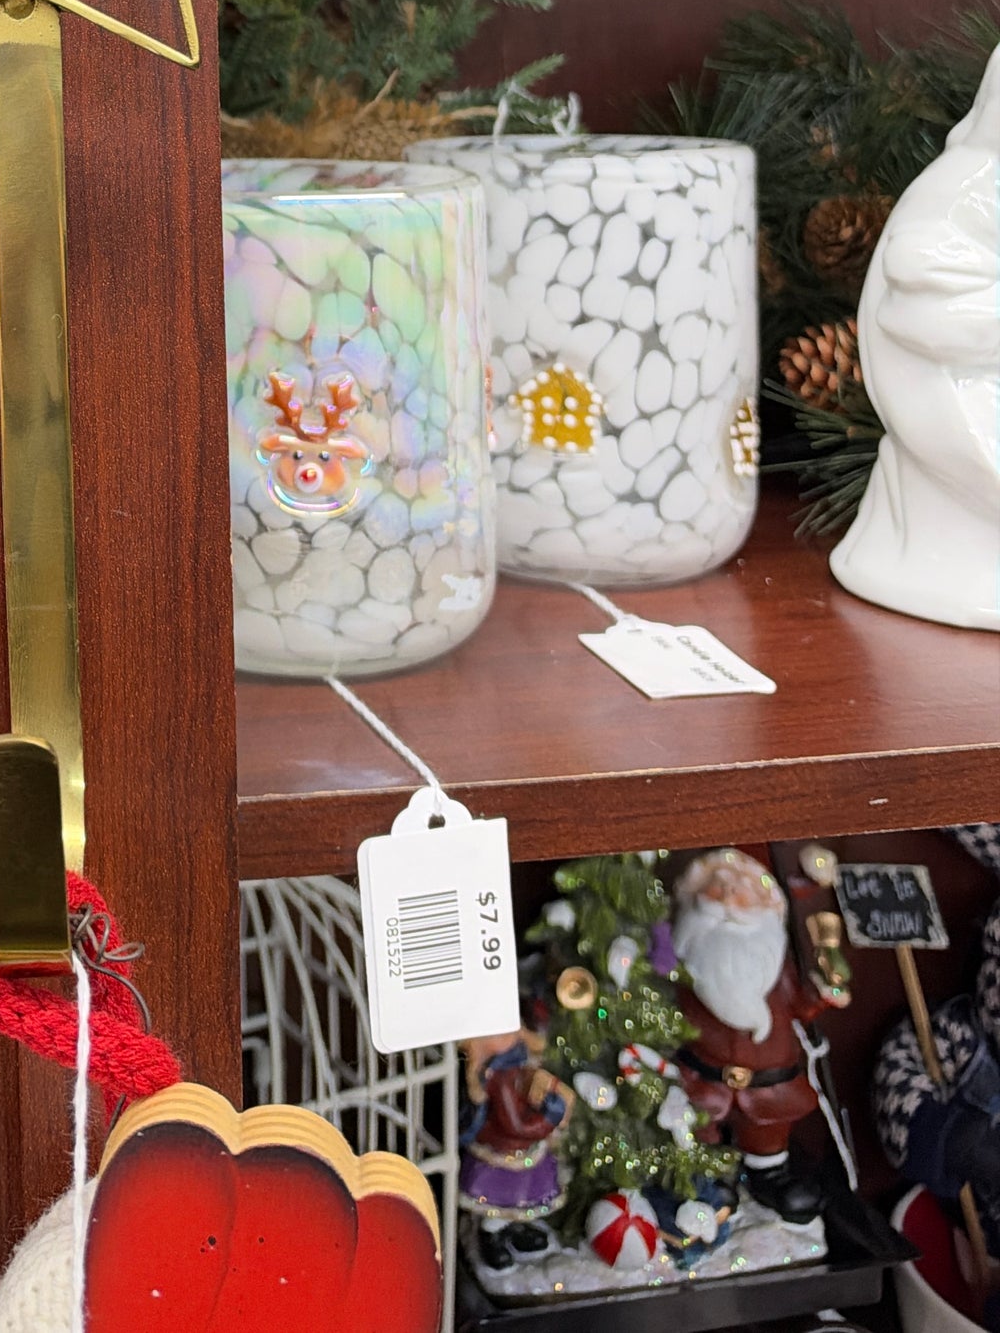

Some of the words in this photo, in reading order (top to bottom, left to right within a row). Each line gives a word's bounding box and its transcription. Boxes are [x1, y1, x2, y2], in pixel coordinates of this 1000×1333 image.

[845, 874, 882, 899] Let
[386, 917, 402, 978] 081522
[475, 891, 502, 971] $7.99
